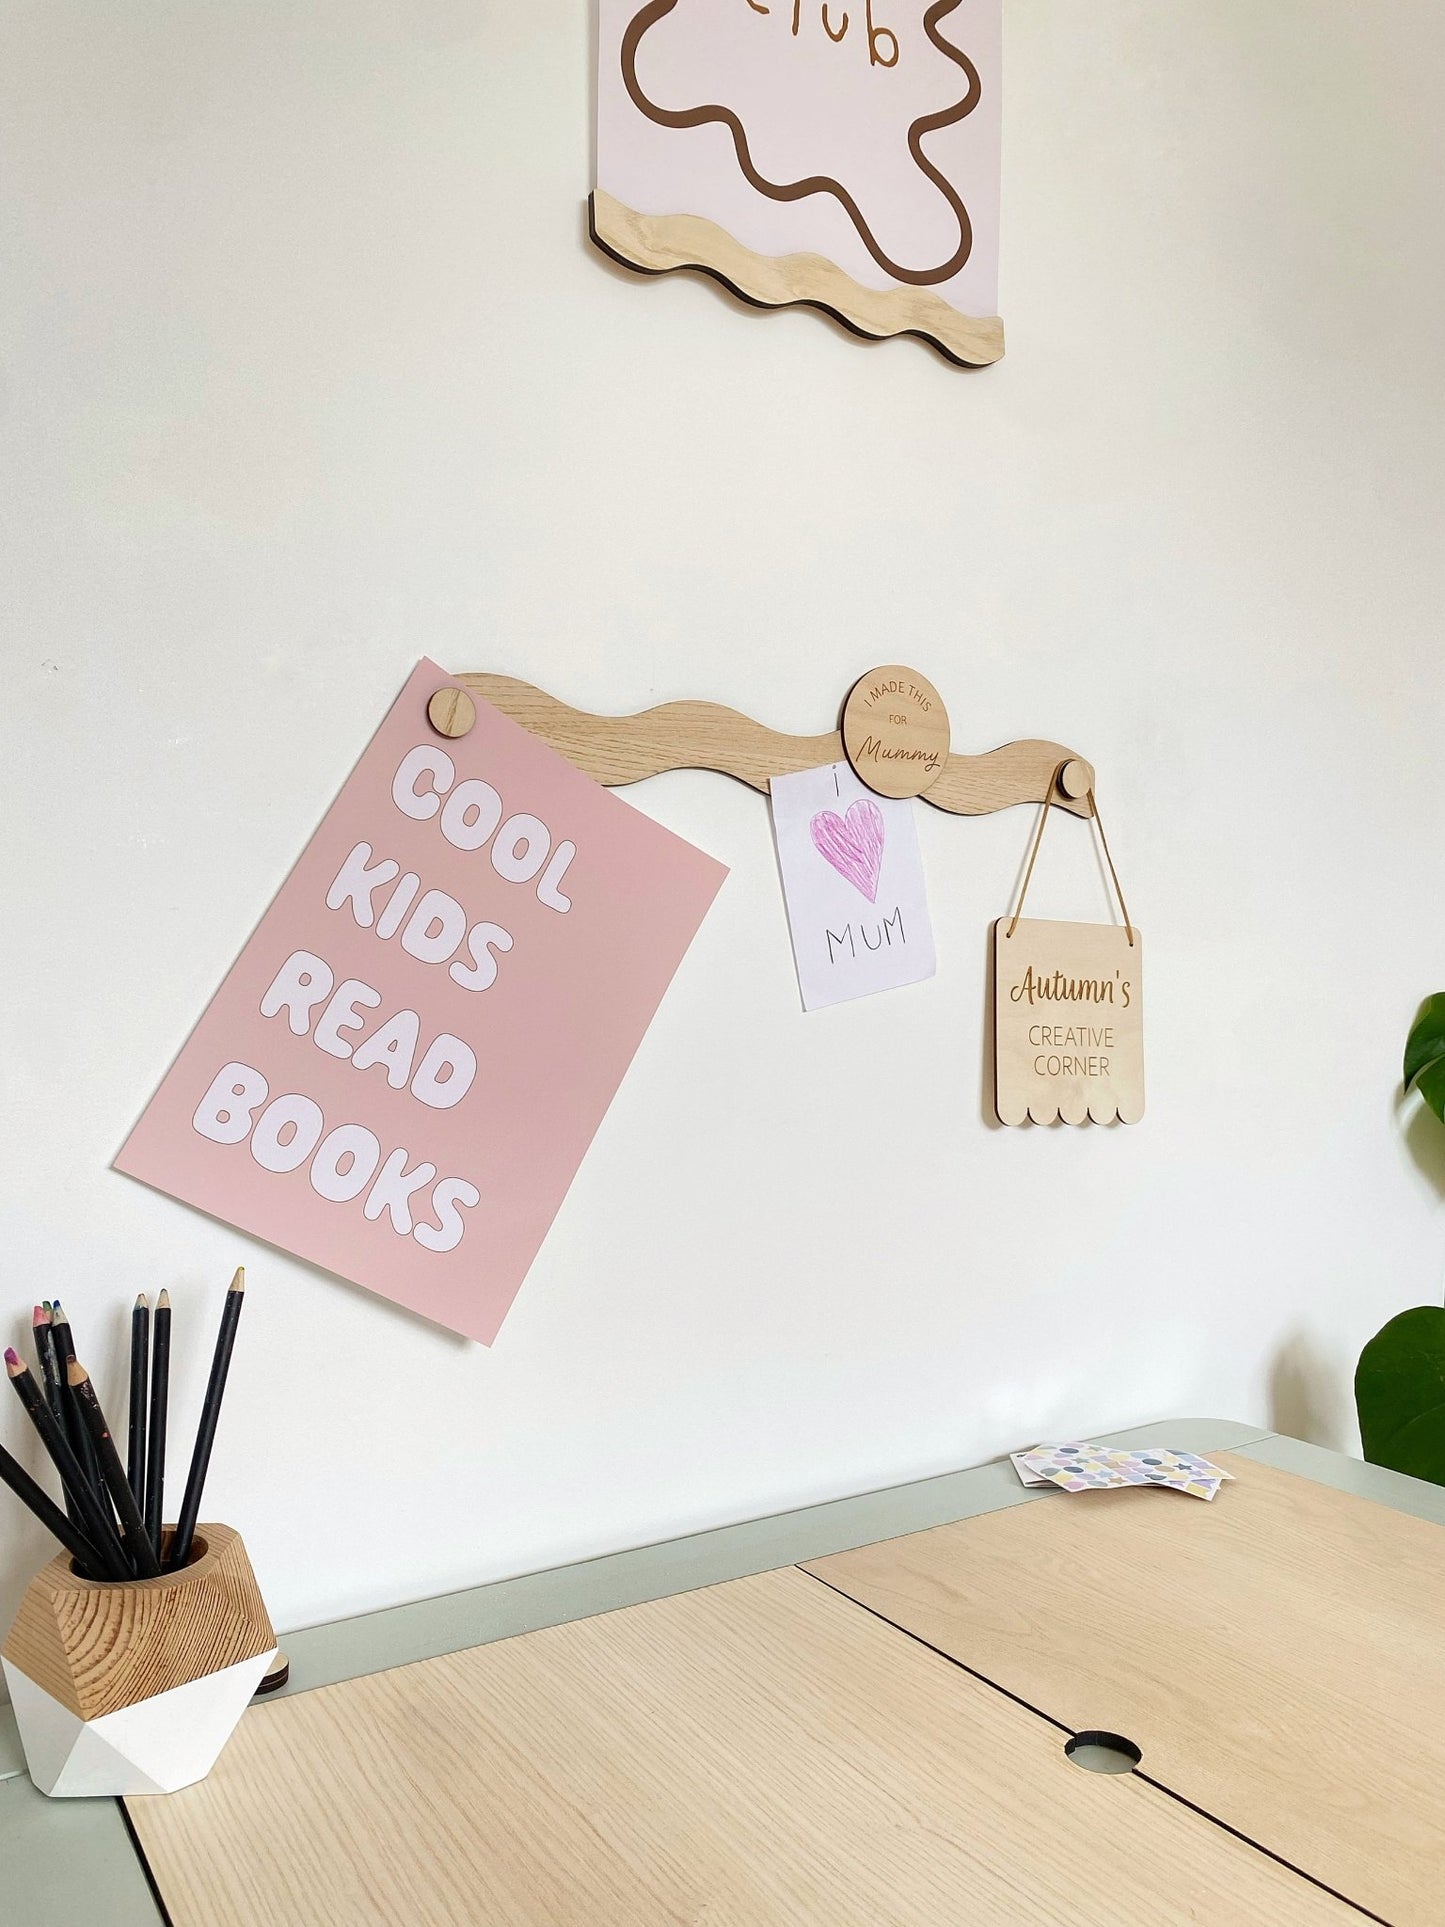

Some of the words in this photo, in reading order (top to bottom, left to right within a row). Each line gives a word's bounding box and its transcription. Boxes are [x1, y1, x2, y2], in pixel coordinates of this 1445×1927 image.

[746, 0, 899, 68] lub
[870, 680, 905, 701] MADE
[908, 685, 932, 713] THIS
[889, 714, 907, 725] FOR
[855, 735, 941, 772] Mummy
[391, 744, 577, 913] COOL
[325, 841, 514, 992] KIDS
[825, 906, 905, 964] MUM
[1010, 965, 1131, 1008] Autumn's
[260, 949, 478, 1109] READ
[1028, 1025, 1115, 1048] CREATIVE
[1034, 1055, 1110, 1077] CORNER
[192, 1061, 481, 1253] BOOKS
